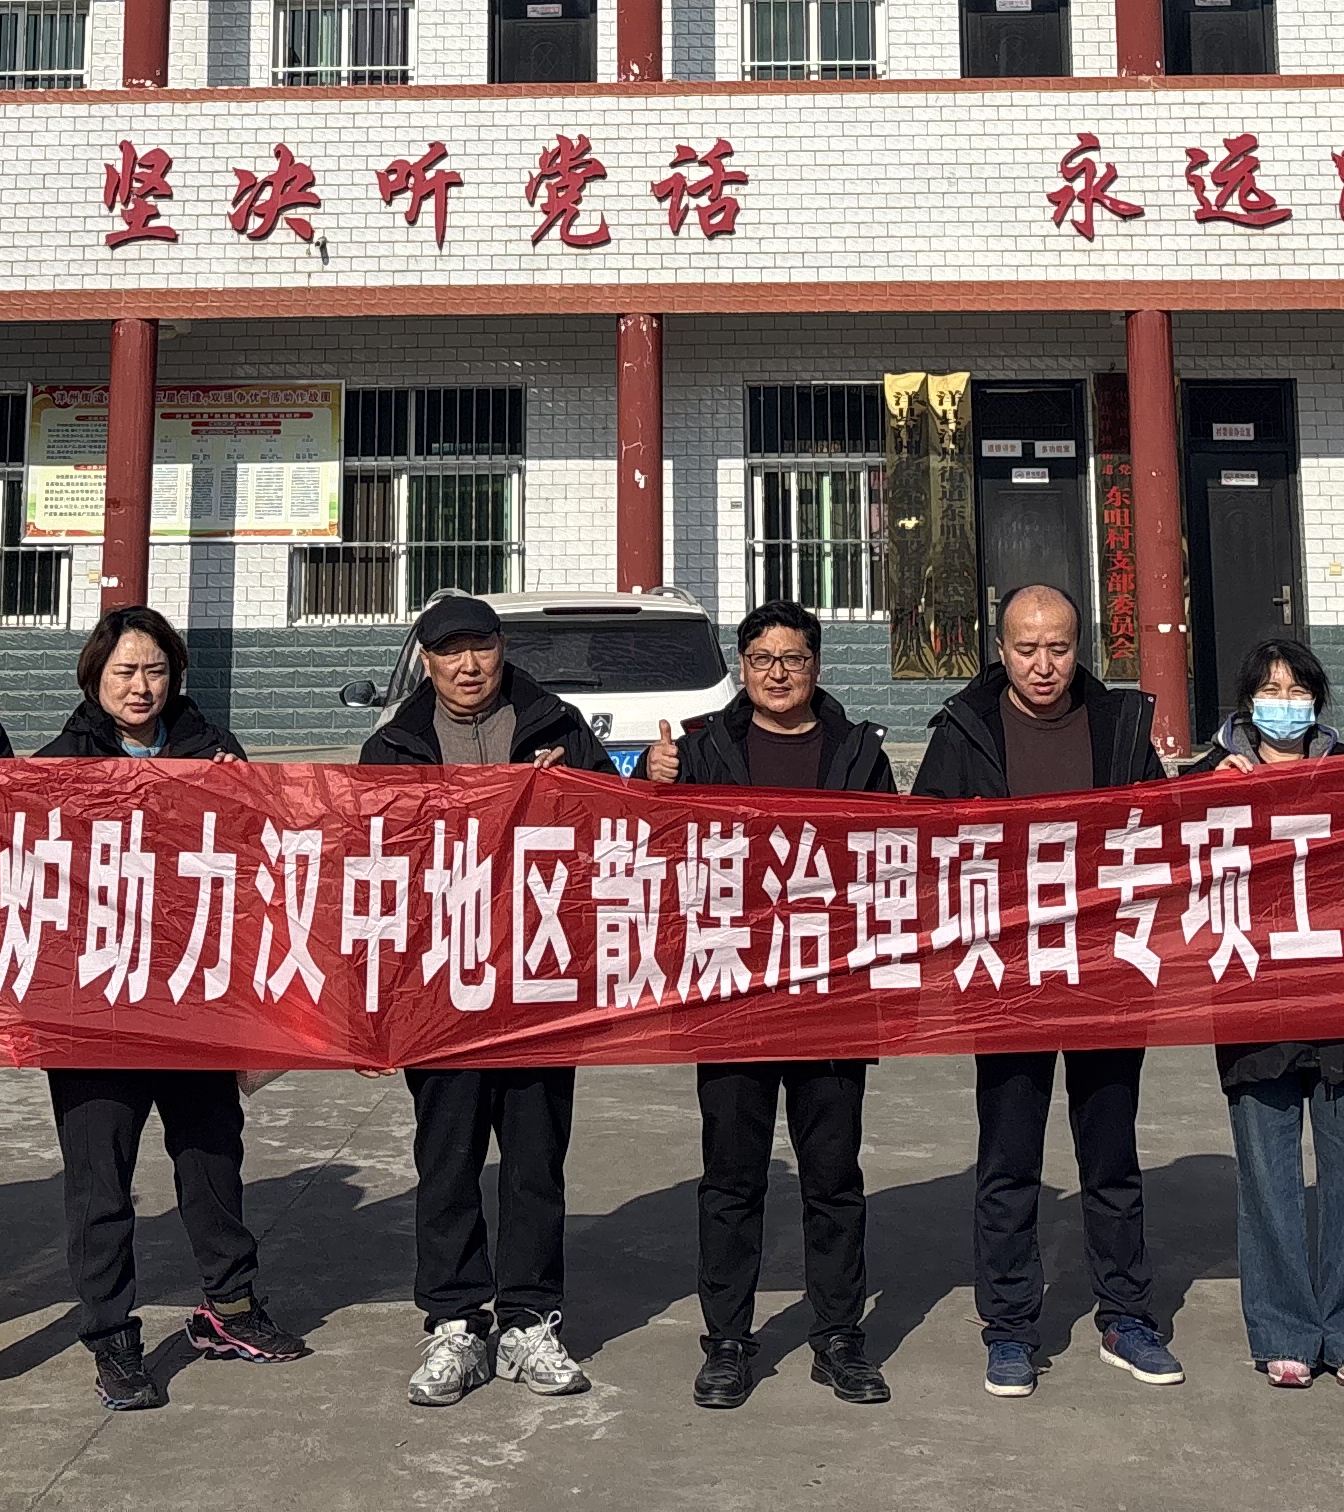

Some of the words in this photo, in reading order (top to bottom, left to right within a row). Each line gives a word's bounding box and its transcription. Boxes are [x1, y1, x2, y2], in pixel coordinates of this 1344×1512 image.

[104, 133, 749, 251] 坚决听党话
[1103, 486, 1136, 660] 东咀村支部委员会
